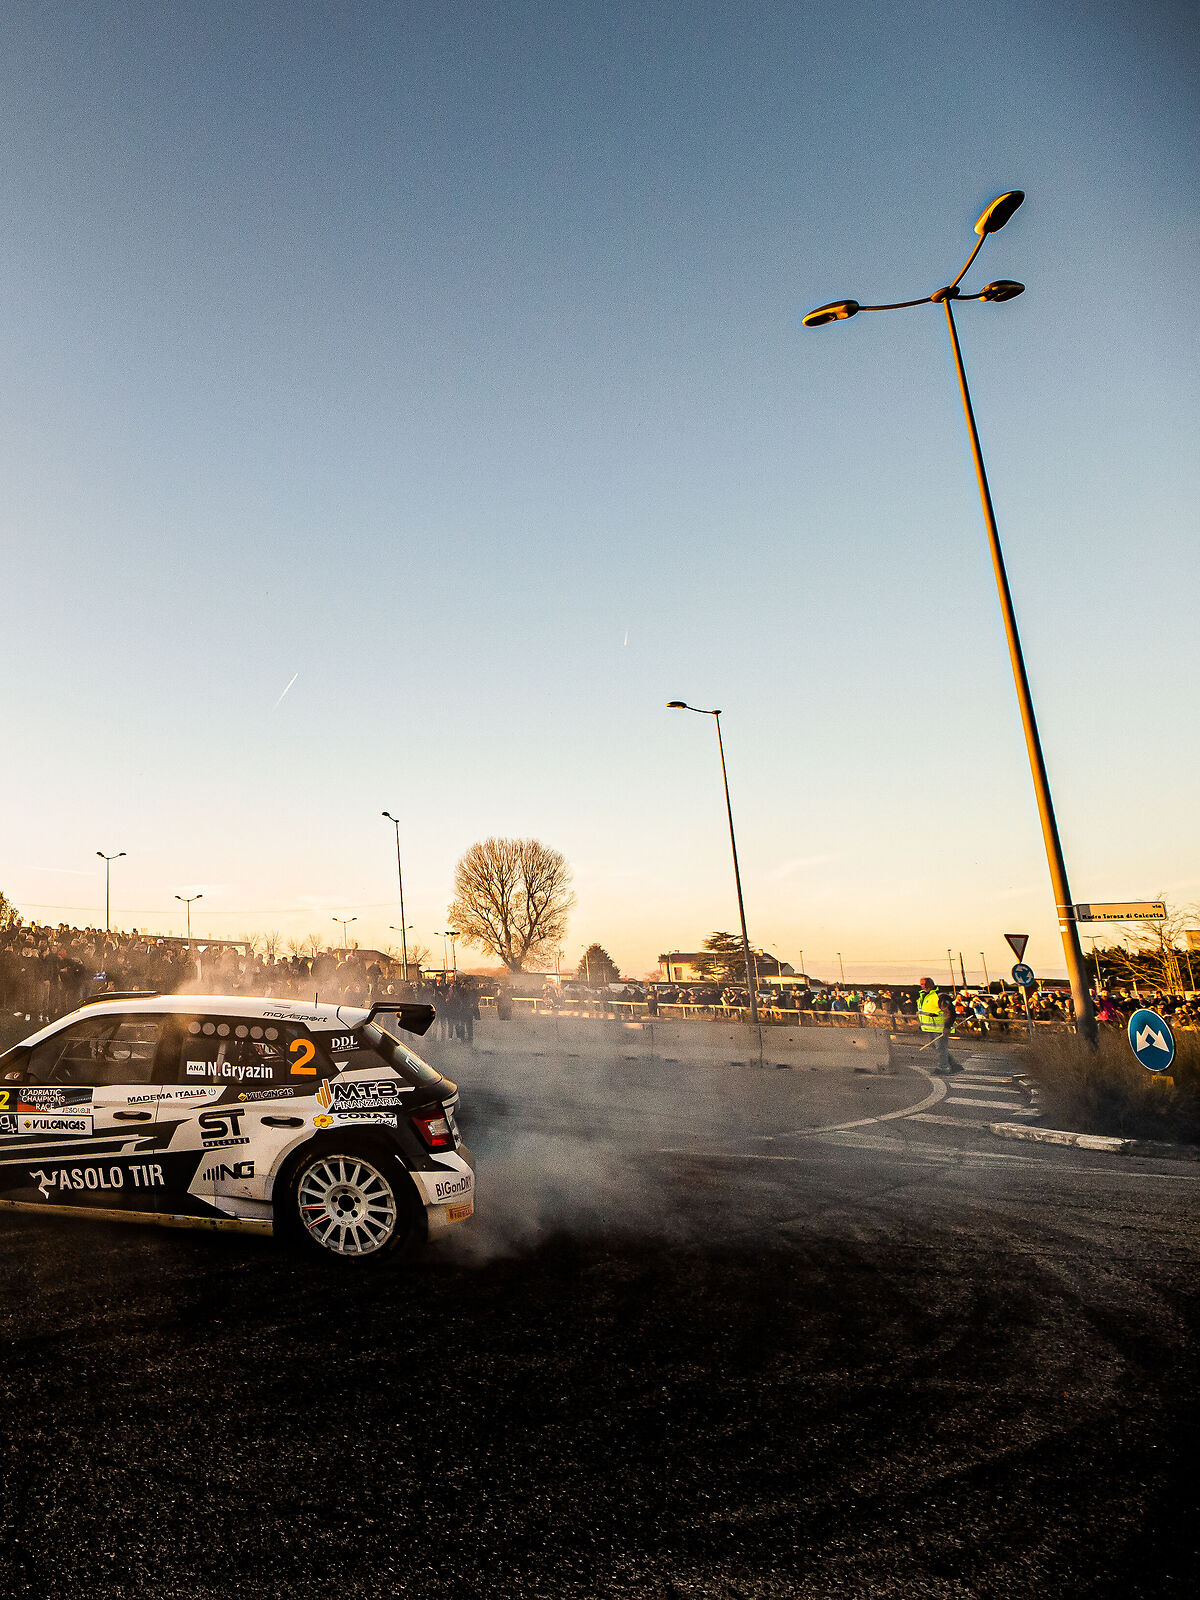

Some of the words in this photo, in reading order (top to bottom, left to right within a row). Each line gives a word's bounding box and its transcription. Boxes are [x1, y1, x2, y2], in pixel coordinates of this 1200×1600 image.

[331, 1035, 358, 1049] DDL
[289, 1038, 317, 1076] 2
[188, 1064, 205, 1072] ANA
[207, 1061, 273, 1080] N.Gryazin
[28, 1088, 62, 1096] ADRIATIC
[127, 1092, 173, 1103] MADEMA
[175, 1088, 207, 1098] ITALIA
[246, 1087, 295, 1100] VULCANGAS
[332, 1081, 400, 1100] MTB
[21, 1095, 66, 1103] CHAMPIONS
[333, 1097, 402, 1110] FINANZIARIA
[35, 1102, 55, 1111] RACE
[32, 1119, 86, 1131] VULCANGAS
[198, 1108, 245, 1139] ST
[60, 1166, 124, 1190] ASOLO
[128, 1164, 166, 1187] TIR
